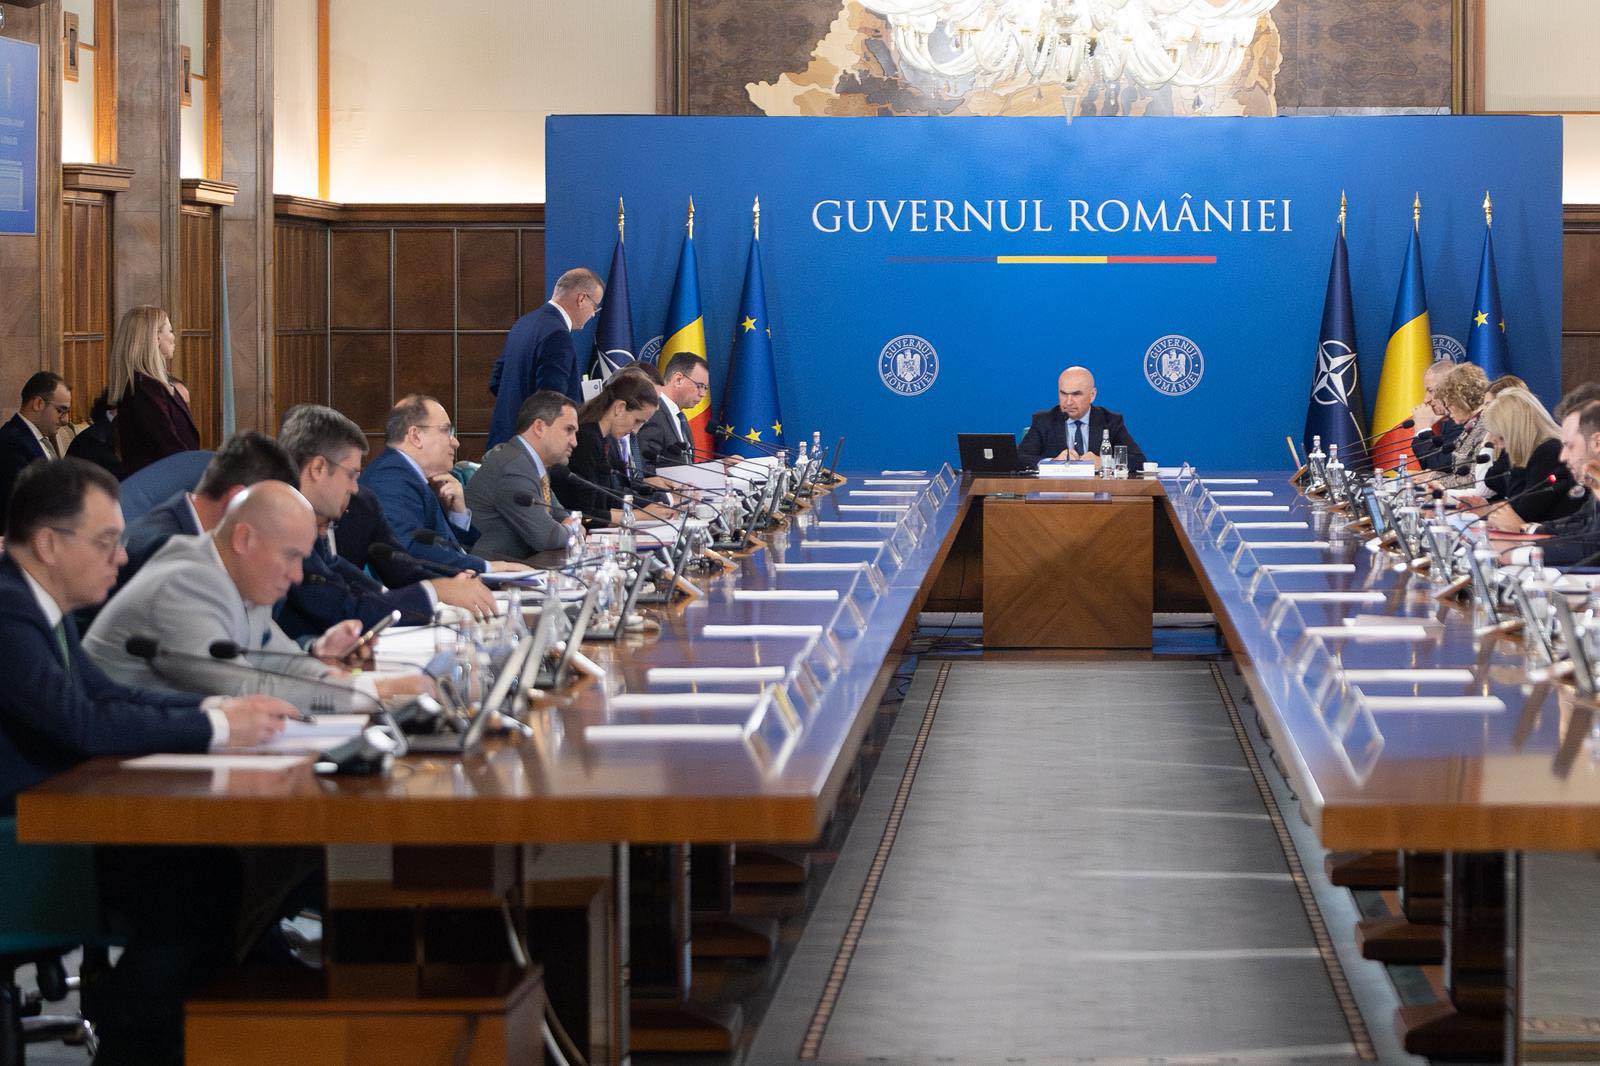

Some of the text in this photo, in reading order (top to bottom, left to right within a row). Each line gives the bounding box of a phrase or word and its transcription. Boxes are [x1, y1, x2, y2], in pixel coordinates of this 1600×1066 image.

[811, 192, 1294, 233] GUVERNUL ROMÂNIEI
[885, 338, 933, 360] GUVERNUL
[1150, 338, 1198, 360] GUVERNUL
[1432, 338, 1463, 359] ERNUL
